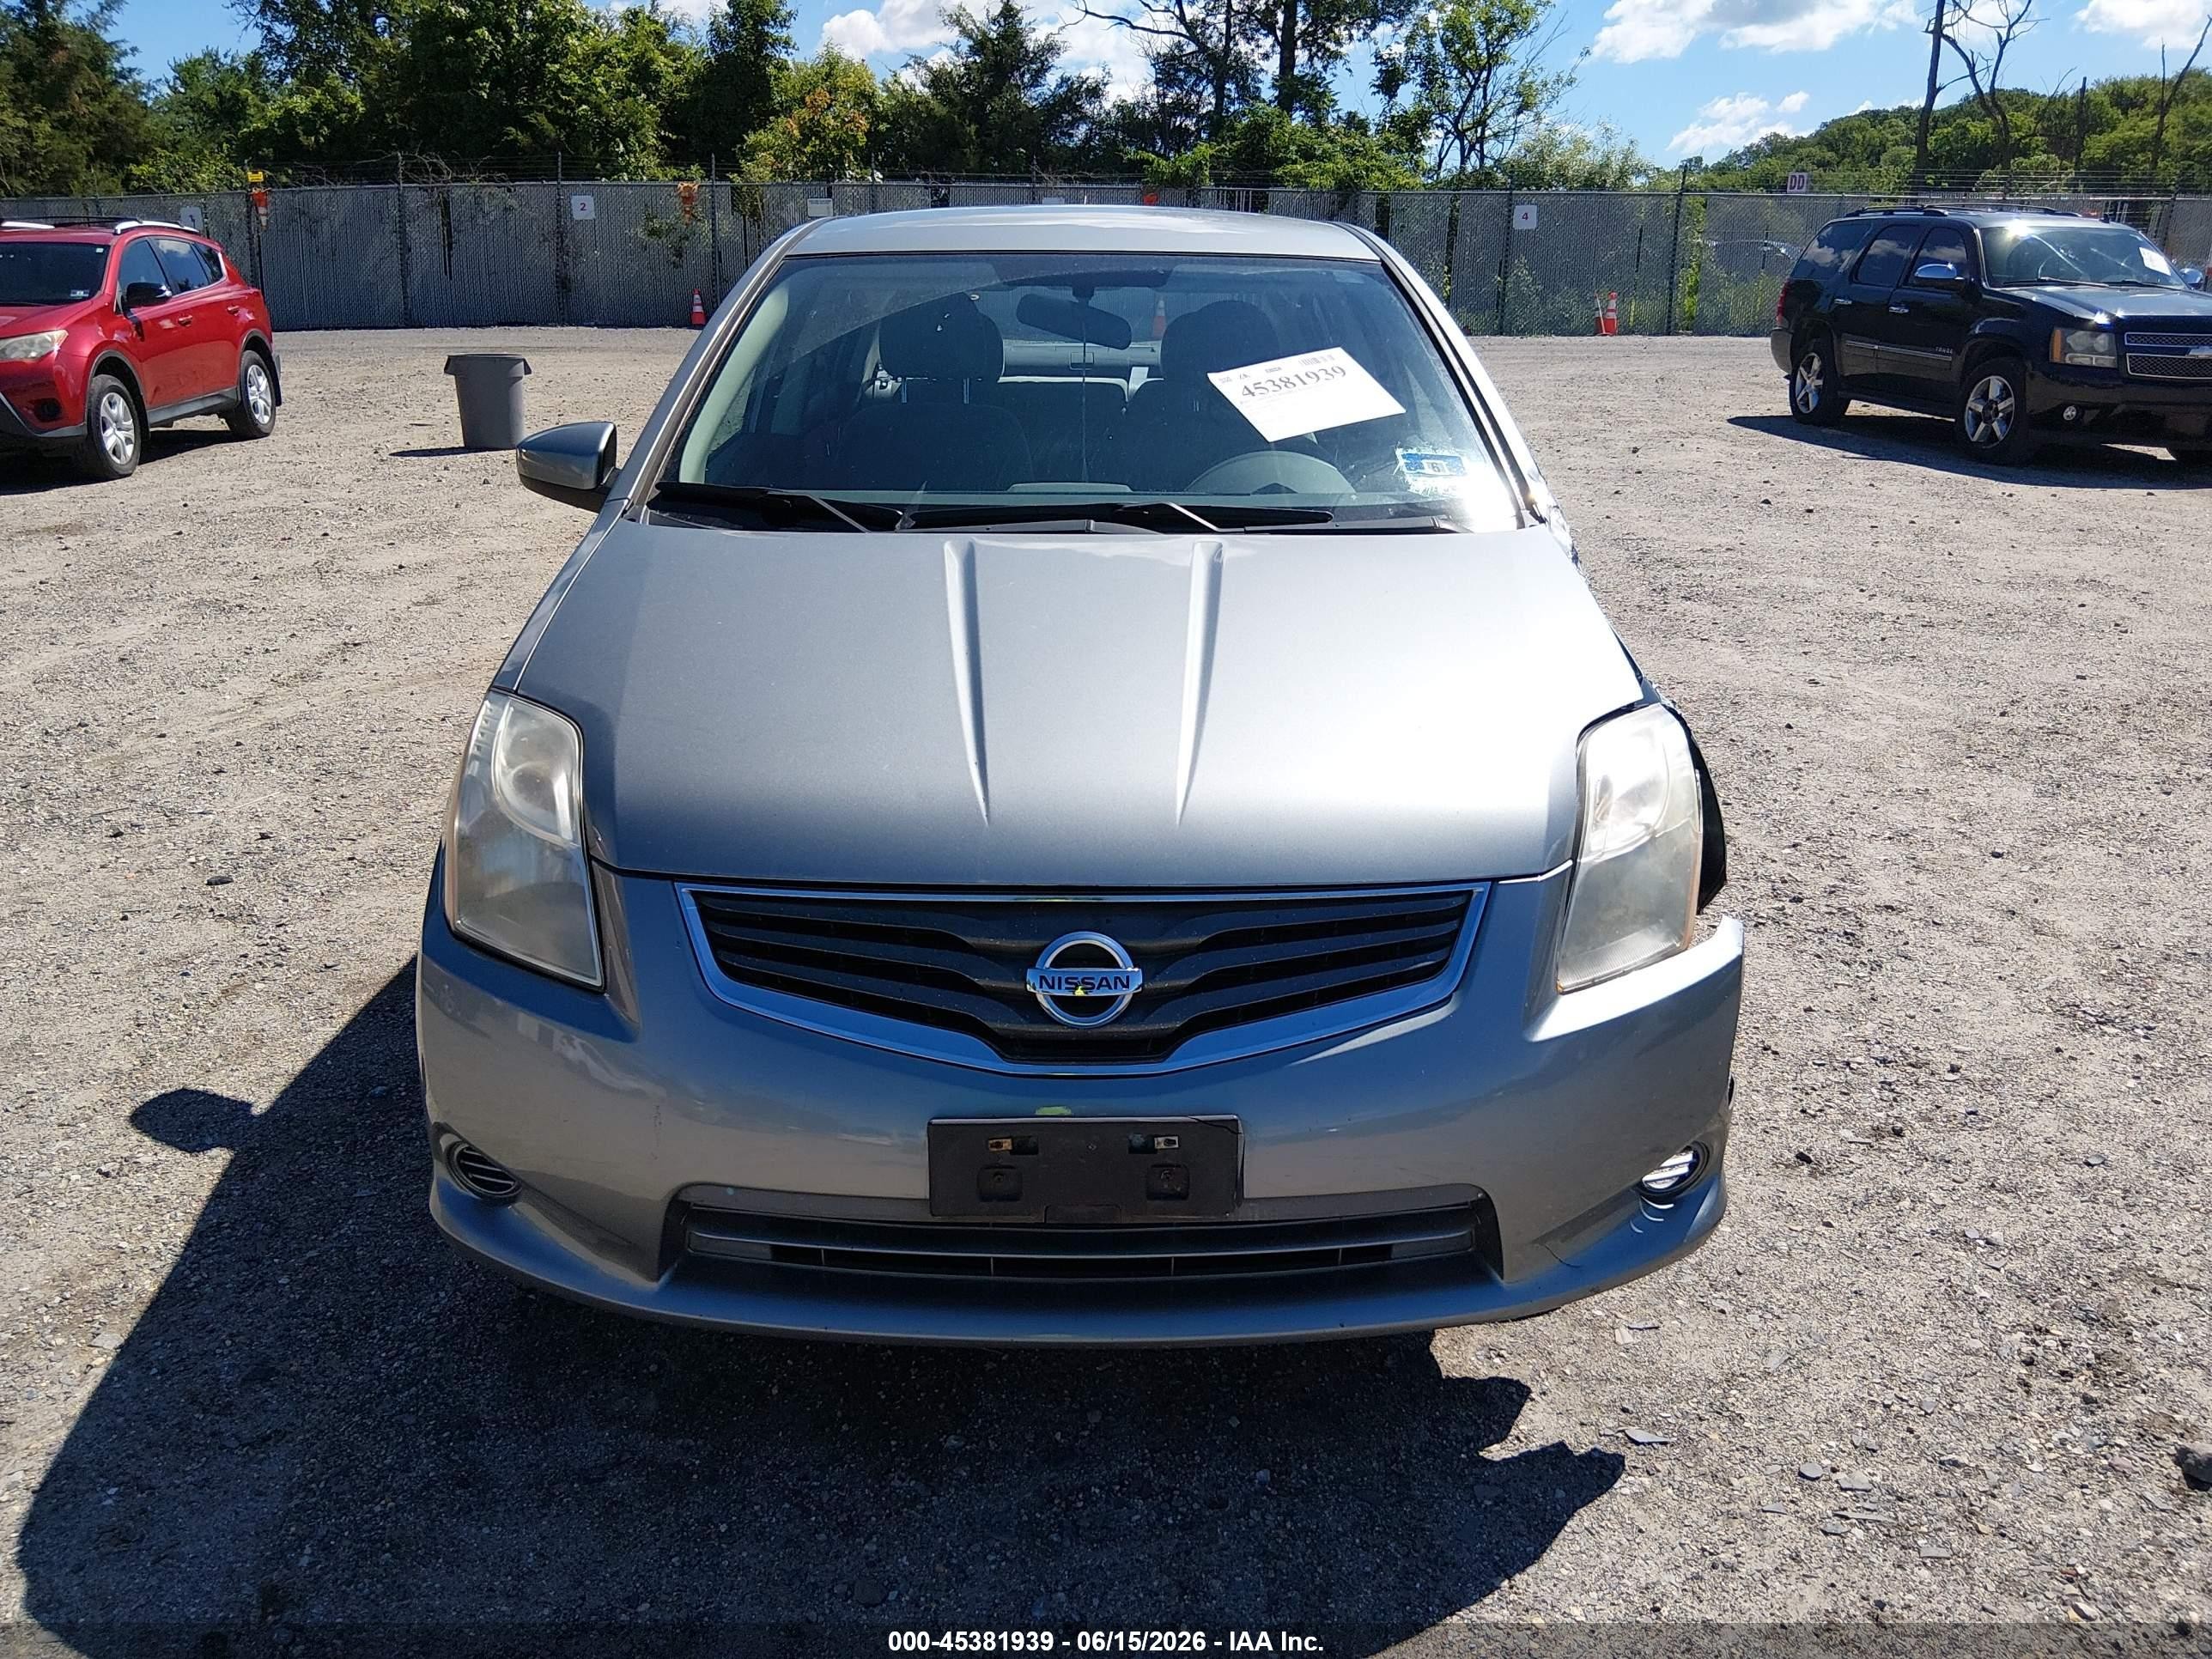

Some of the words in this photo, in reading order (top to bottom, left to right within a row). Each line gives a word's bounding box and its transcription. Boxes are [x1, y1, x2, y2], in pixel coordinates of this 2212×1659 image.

[1789, 174, 1805, 190] DD
[580, 202, 586, 211] 2
[1522, 212, 1528, 221] 4
[1241, 365, 1346, 397] 45381939
[1038, 975, 1129, 990] NISSAN
